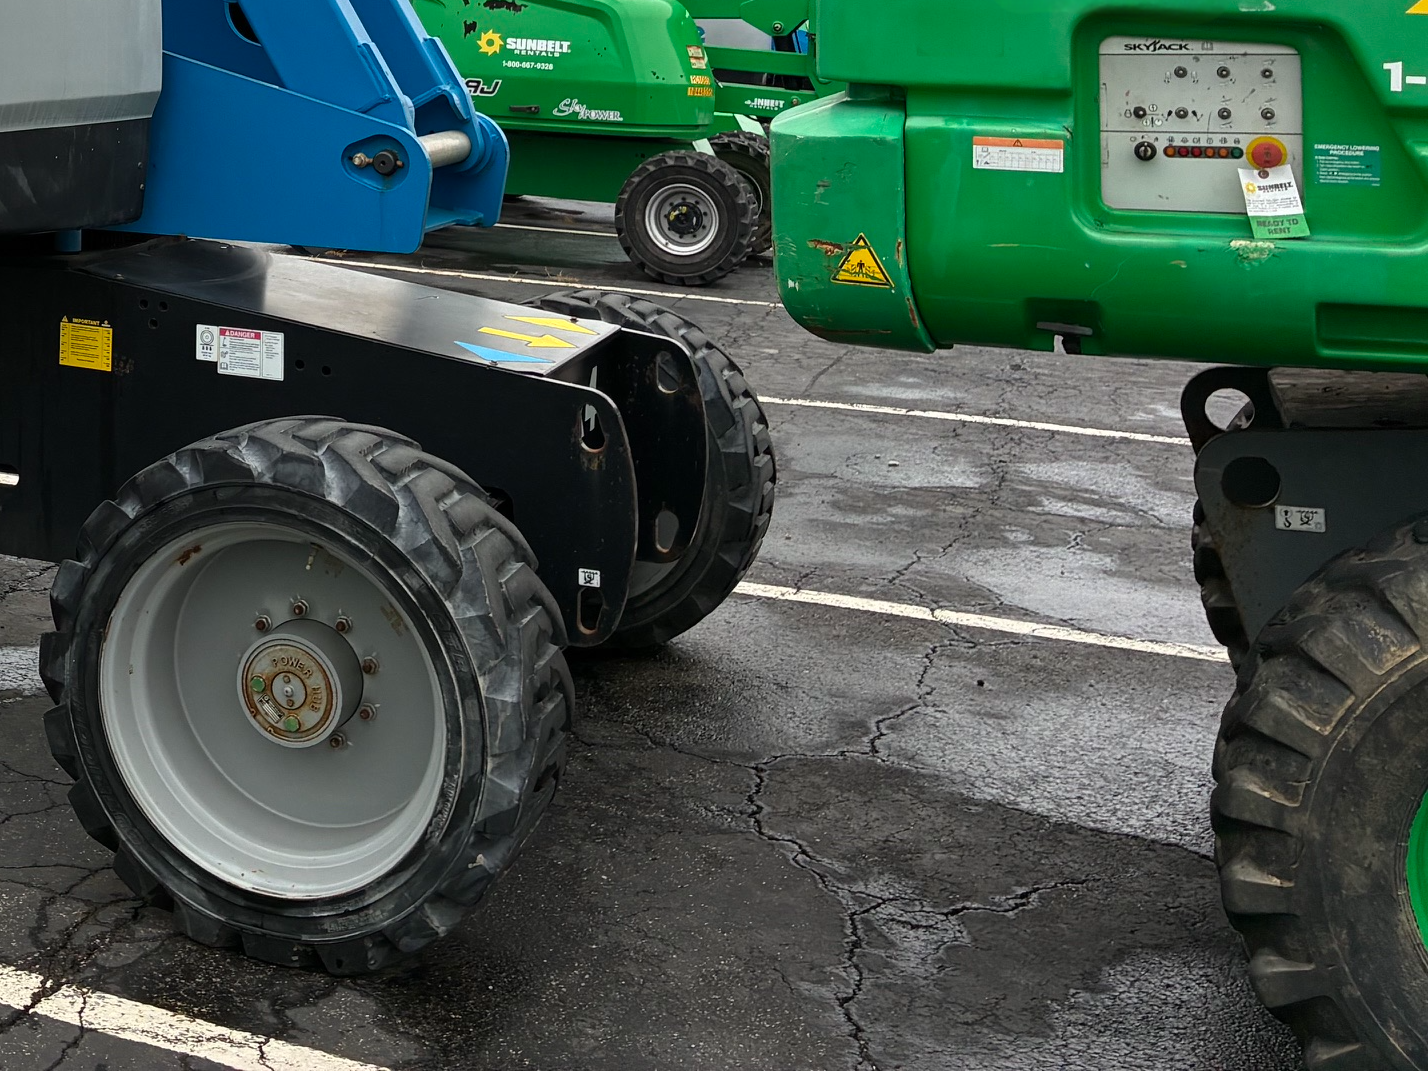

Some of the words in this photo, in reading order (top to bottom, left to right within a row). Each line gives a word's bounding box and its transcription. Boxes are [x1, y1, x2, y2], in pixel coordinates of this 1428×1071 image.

[506, 37, 570, 53] SUNBELT
[1124, 40, 1190, 52] SKYJACK
[1268, 227, 1291, 235] RENT
[72, 318, 100, 326] IMPORTANT
[272, 655, 313, 679] POWER
[310, 685, 322, 712] HUB
